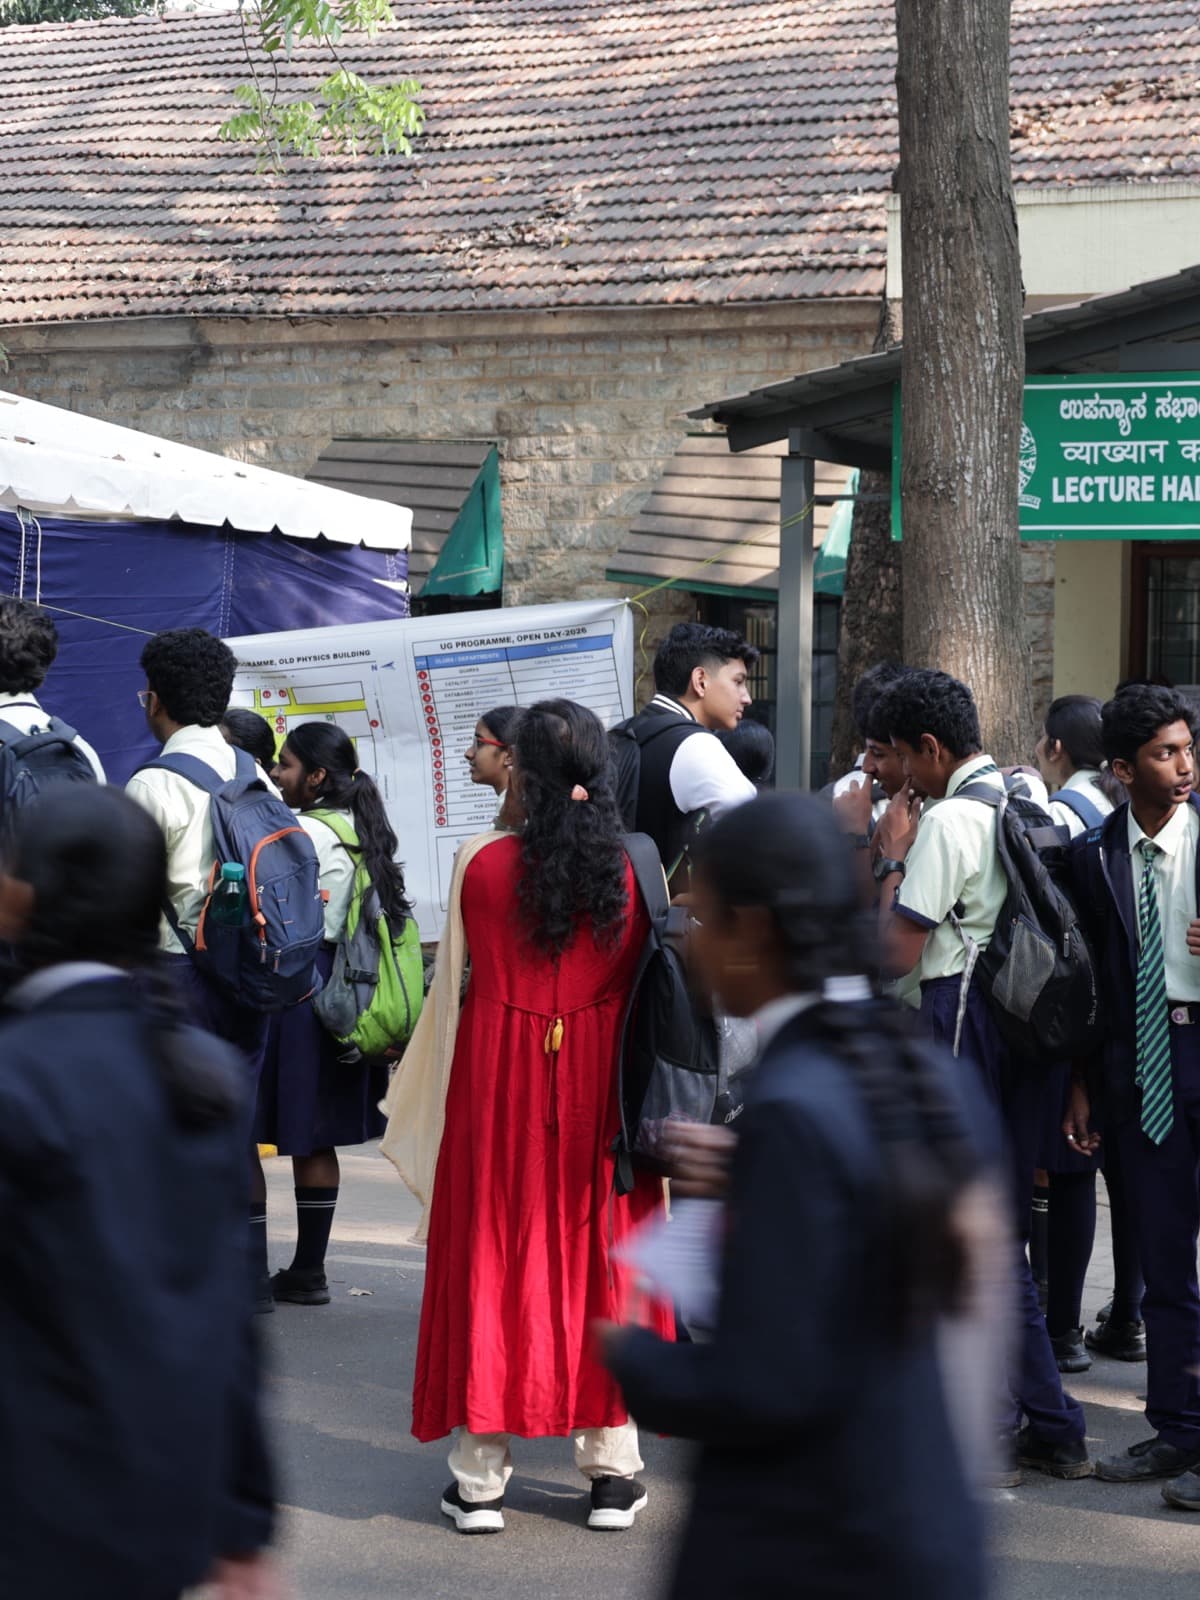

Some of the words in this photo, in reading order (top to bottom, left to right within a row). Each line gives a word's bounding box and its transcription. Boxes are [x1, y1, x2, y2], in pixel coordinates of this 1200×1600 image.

[1060, 392, 1147, 436] ಉಪನ್ಯಾಸ
[1060, 441, 1168, 464] व्याख्यान
[1053, 476, 1154, 502] LECTURE
[440, 641, 453, 650] UG
[455, 636, 515, 648] PROGRAMME,
[517, 631, 541, 642] OPEN
[543, 626, 587, 639] DAY-2026
[278, 657, 295, 665] OLD
[296, 653, 331, 663] PHYSICS
[333, 648, 371, 660] BUILDING
[371, 664, 378, 672] N
